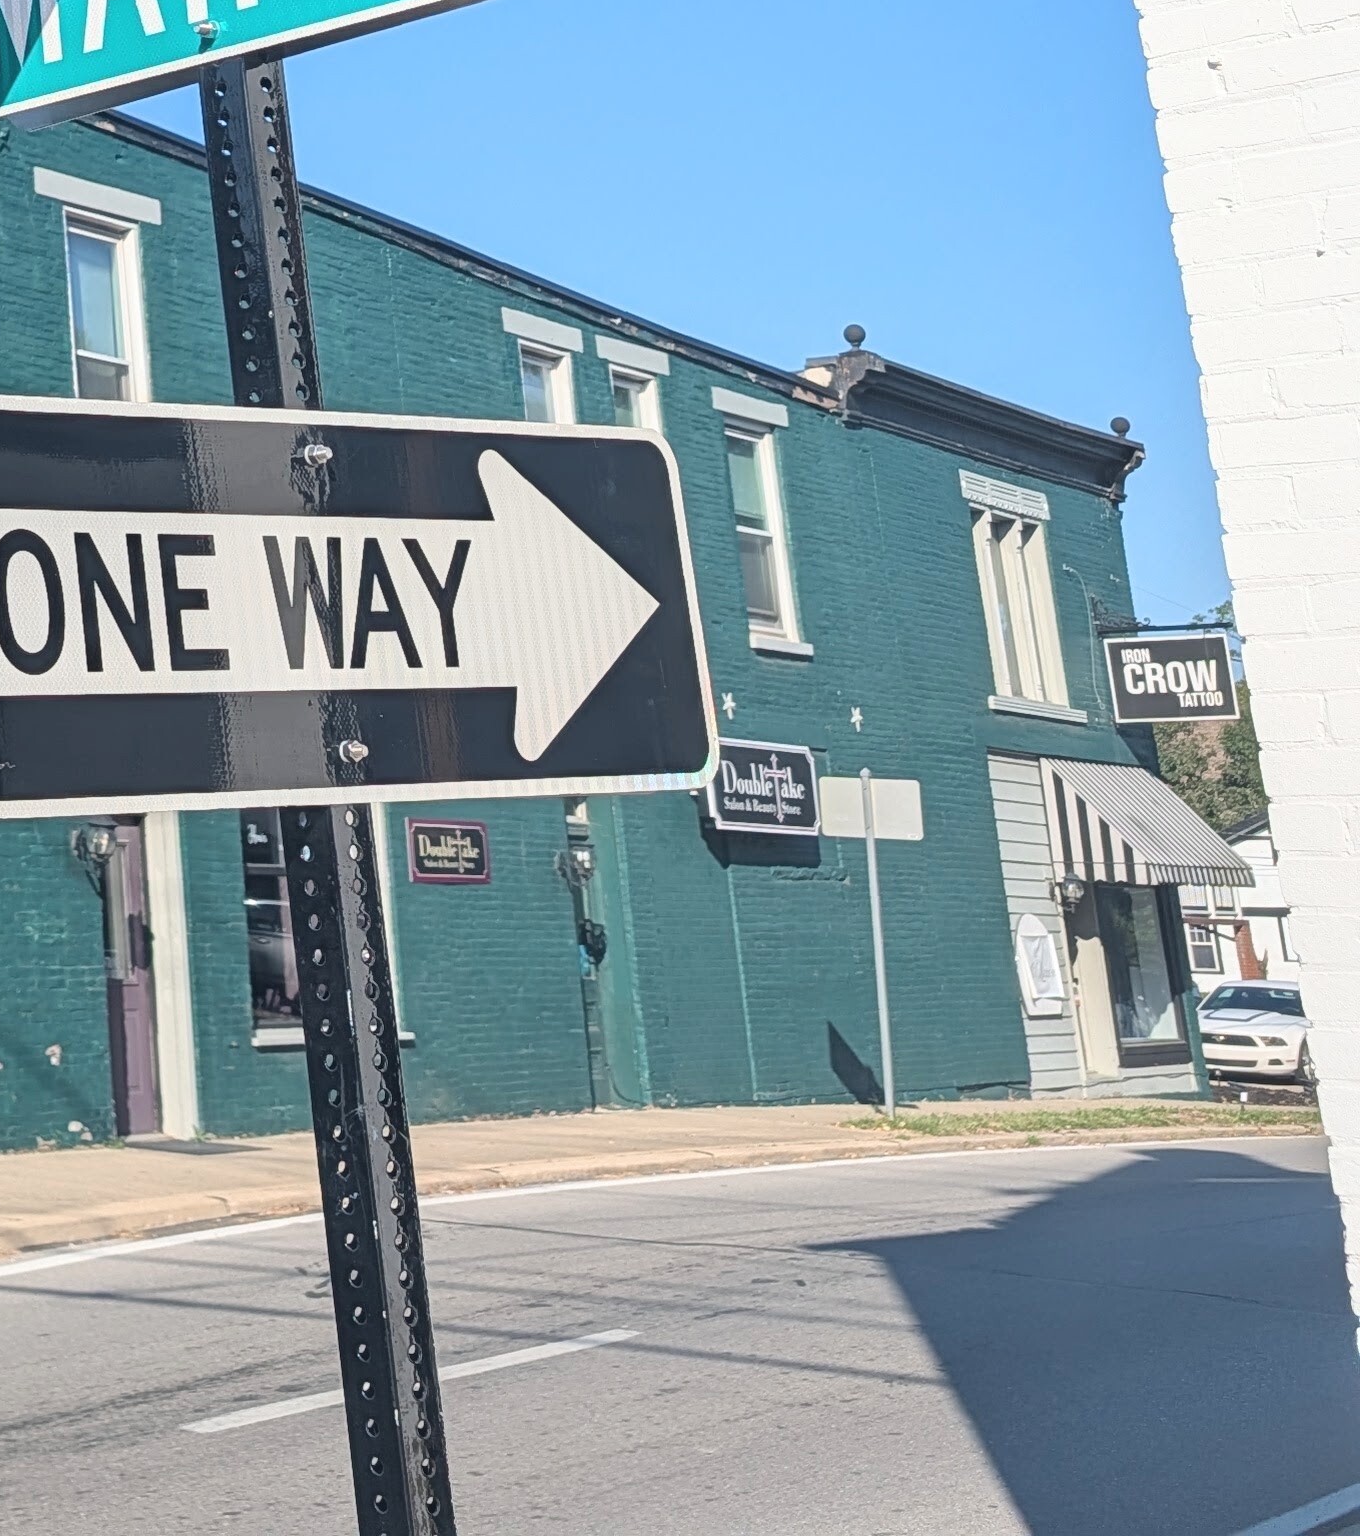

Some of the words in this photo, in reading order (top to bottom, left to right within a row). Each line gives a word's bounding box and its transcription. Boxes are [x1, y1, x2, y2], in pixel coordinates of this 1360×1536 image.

[262, 535, 472, 671] WAY
[1120, 648, 1151, 664] IRON
[1123, 659, 1218, 695] CROW
[1176, 691, 1225, 708] TATTOO
[721, 759, 774, 798] Double
